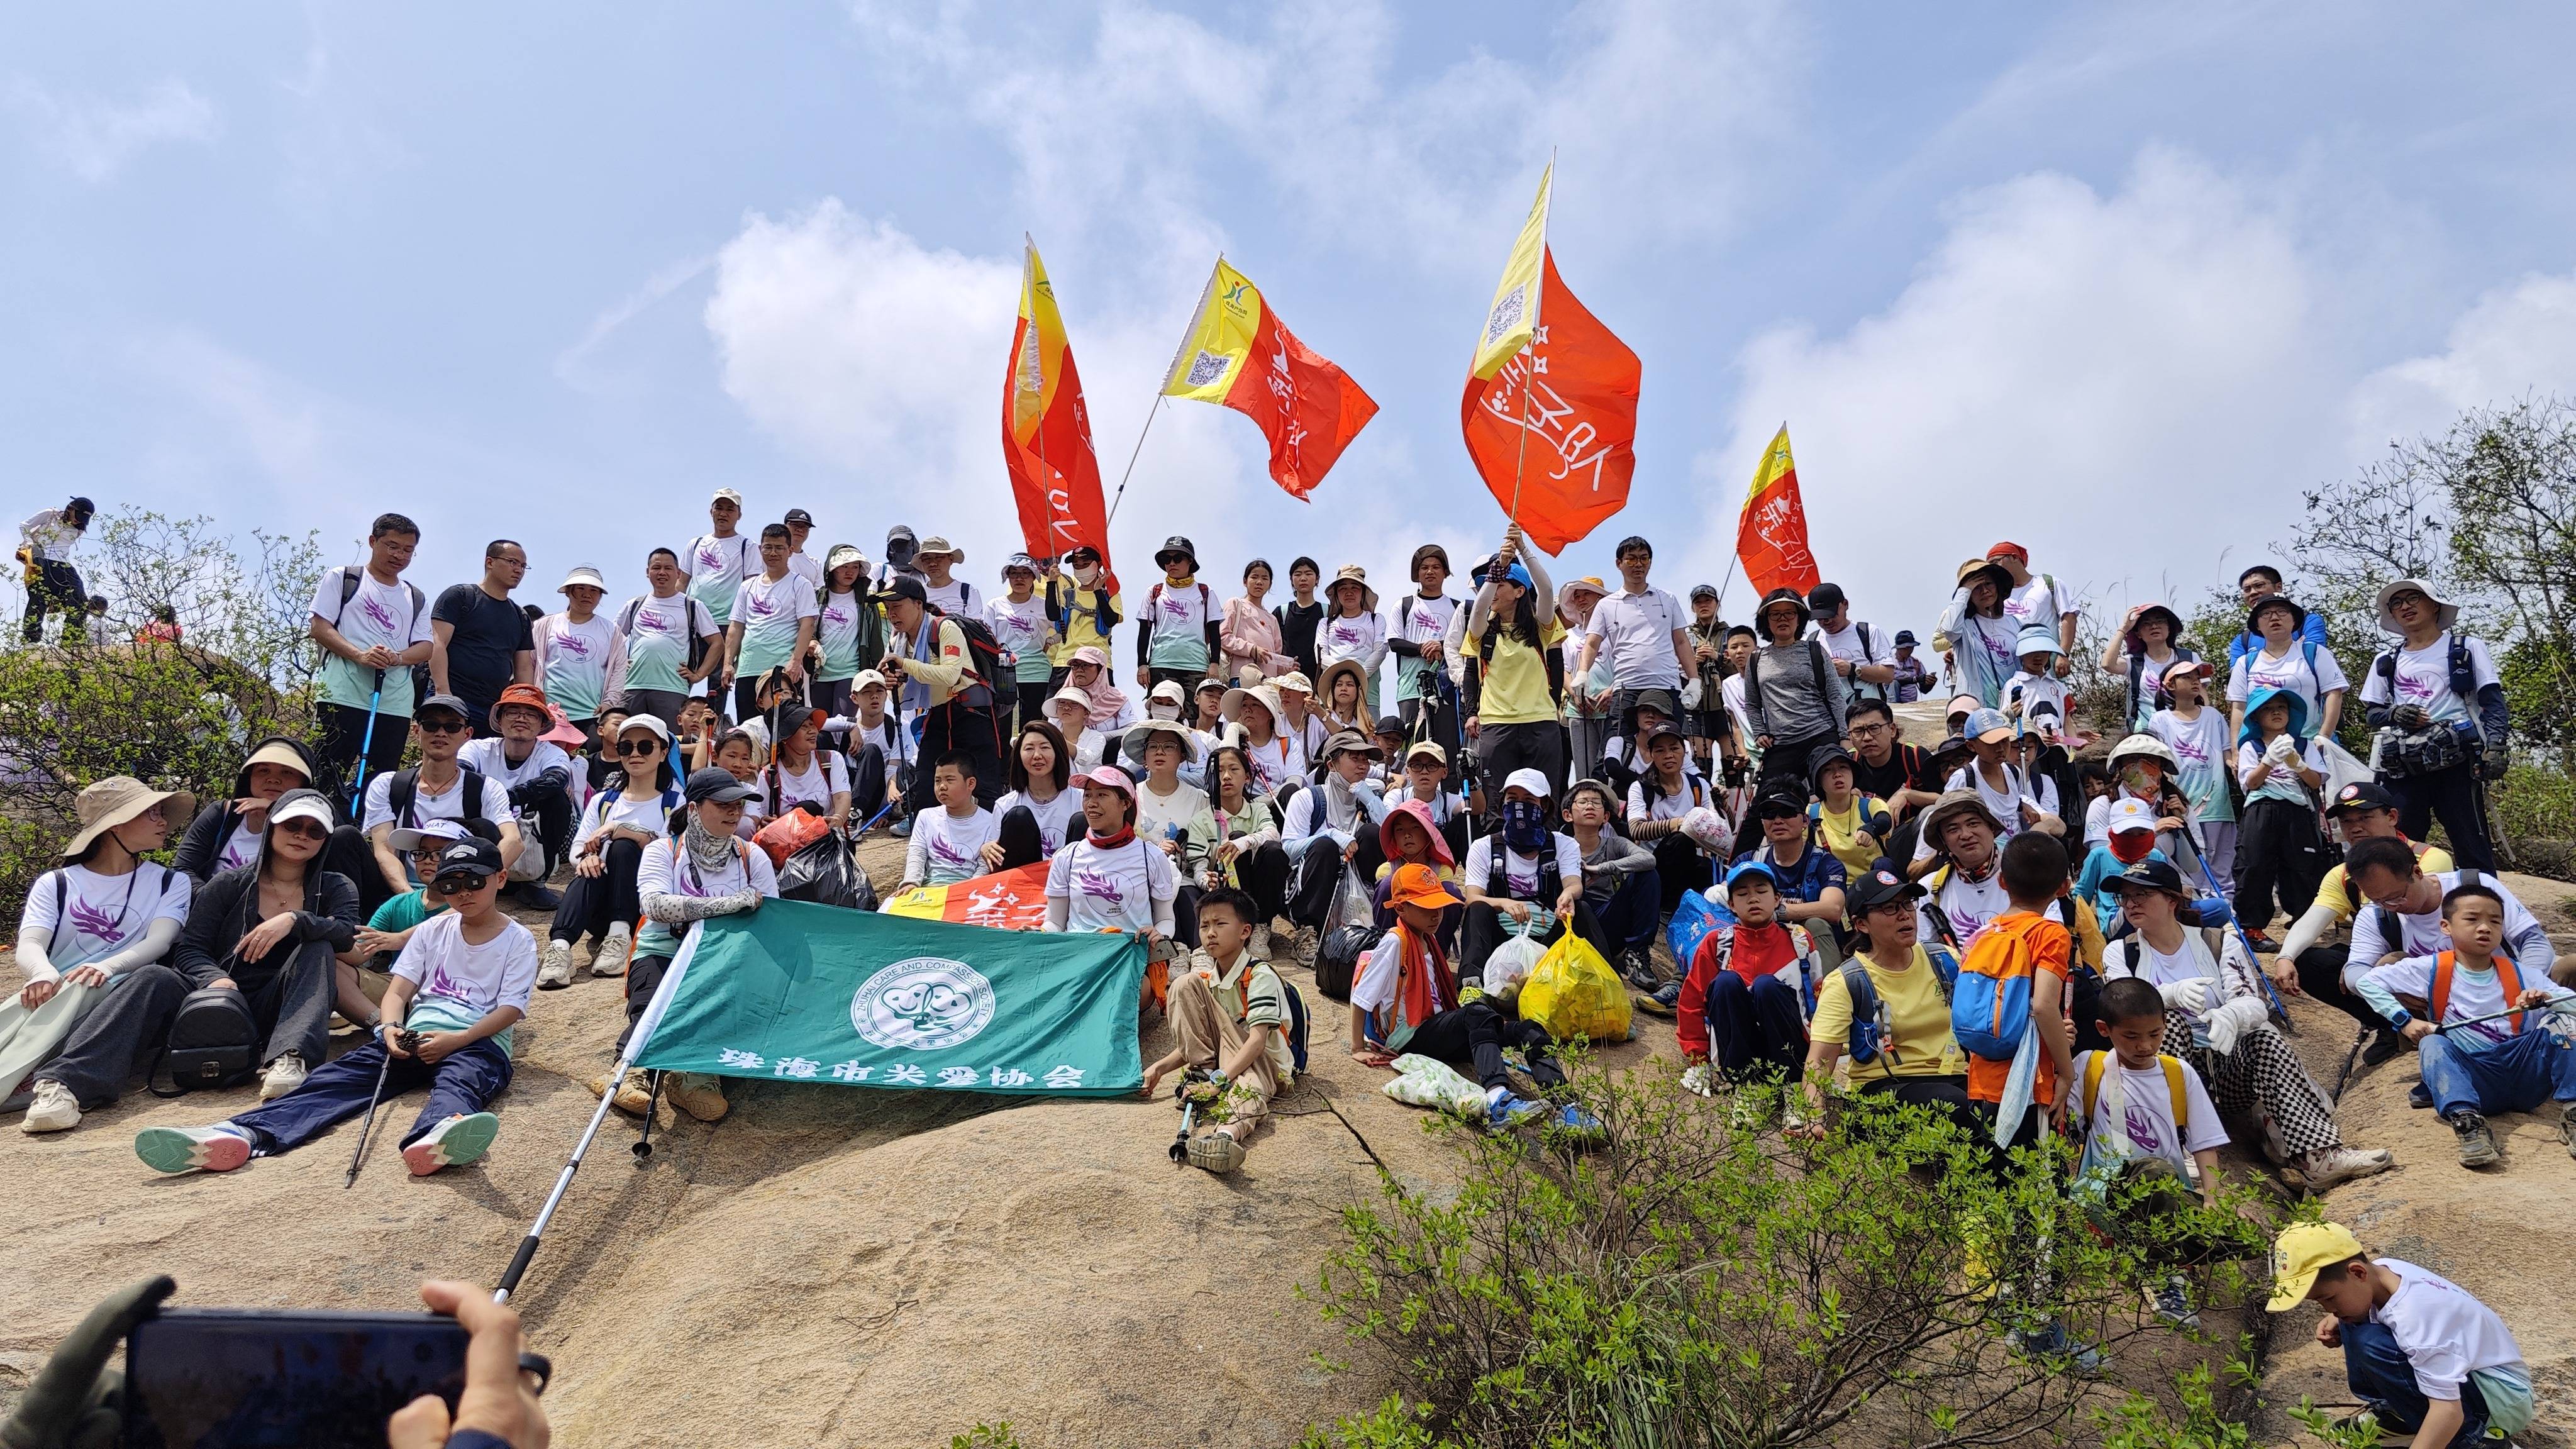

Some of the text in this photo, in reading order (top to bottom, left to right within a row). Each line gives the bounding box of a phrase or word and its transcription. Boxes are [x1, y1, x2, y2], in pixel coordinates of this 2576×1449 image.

[2050, 686, 2060, 699] 04
[857, 961, 992, 1018] ZHUHAI CARE AND COMPASSION SOCIETY
[717, 1047, 1087, 1088] 珠海市关爱协会
